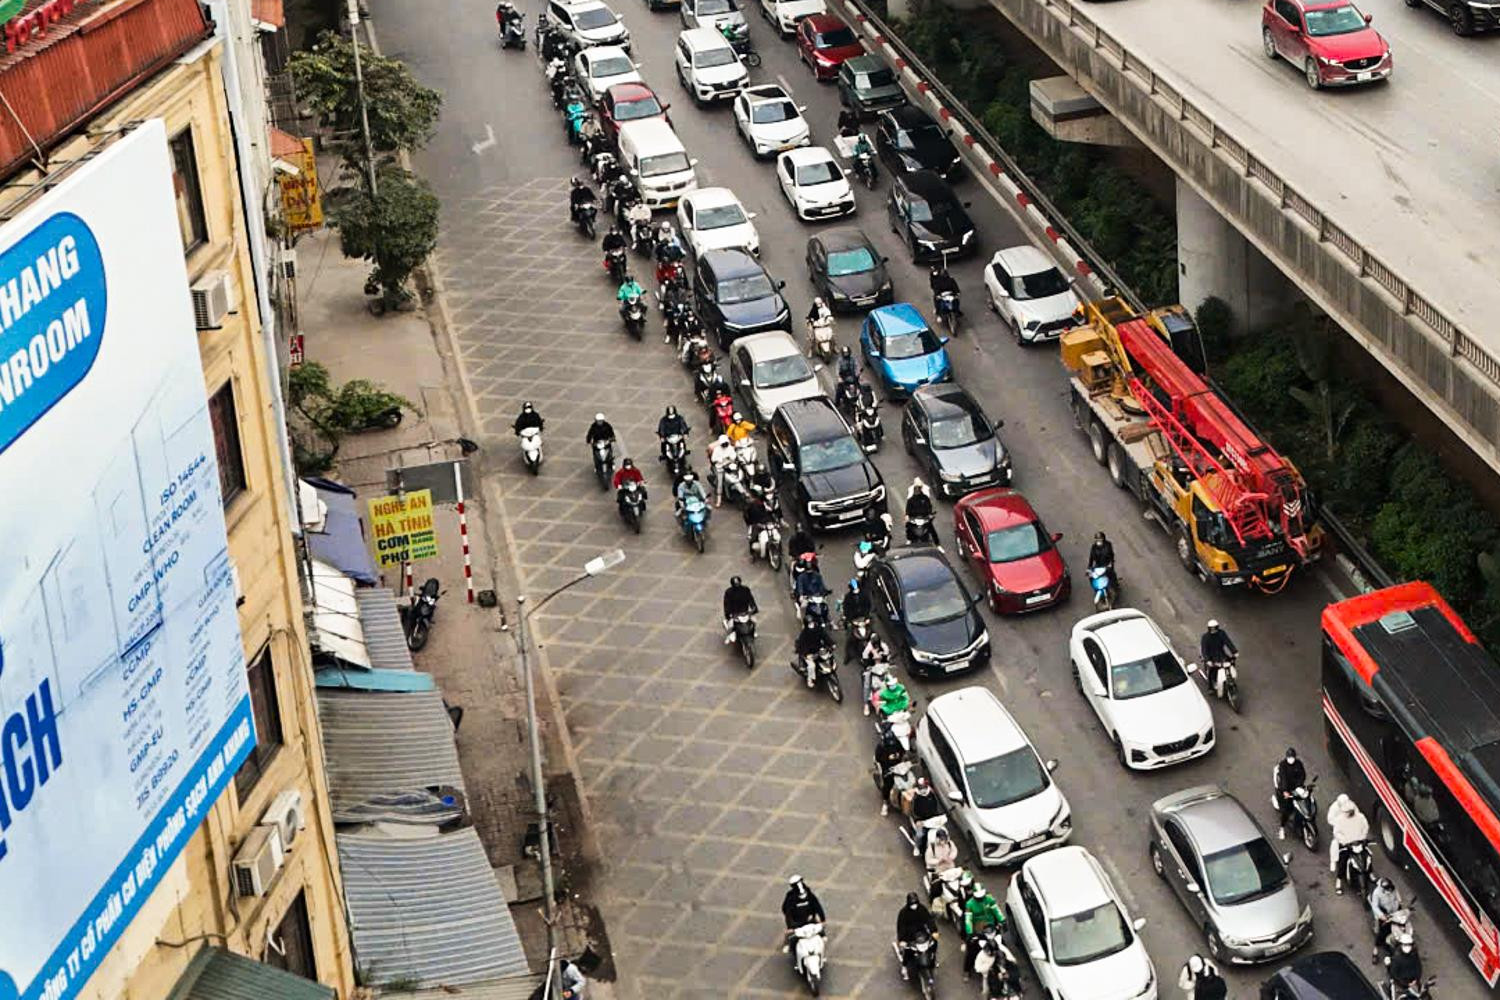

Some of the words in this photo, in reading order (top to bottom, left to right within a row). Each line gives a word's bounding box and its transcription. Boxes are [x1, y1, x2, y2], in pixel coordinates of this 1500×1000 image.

[0, 235, 80, 334] HANG
[159, 482, 178, 507] ISO
[142, 519, 172, 554] CLEAN
[171, 490, 198, 522] ROOM
[375, 519, 395, 538] HÀ
[66, 947, 80, 979] TY
